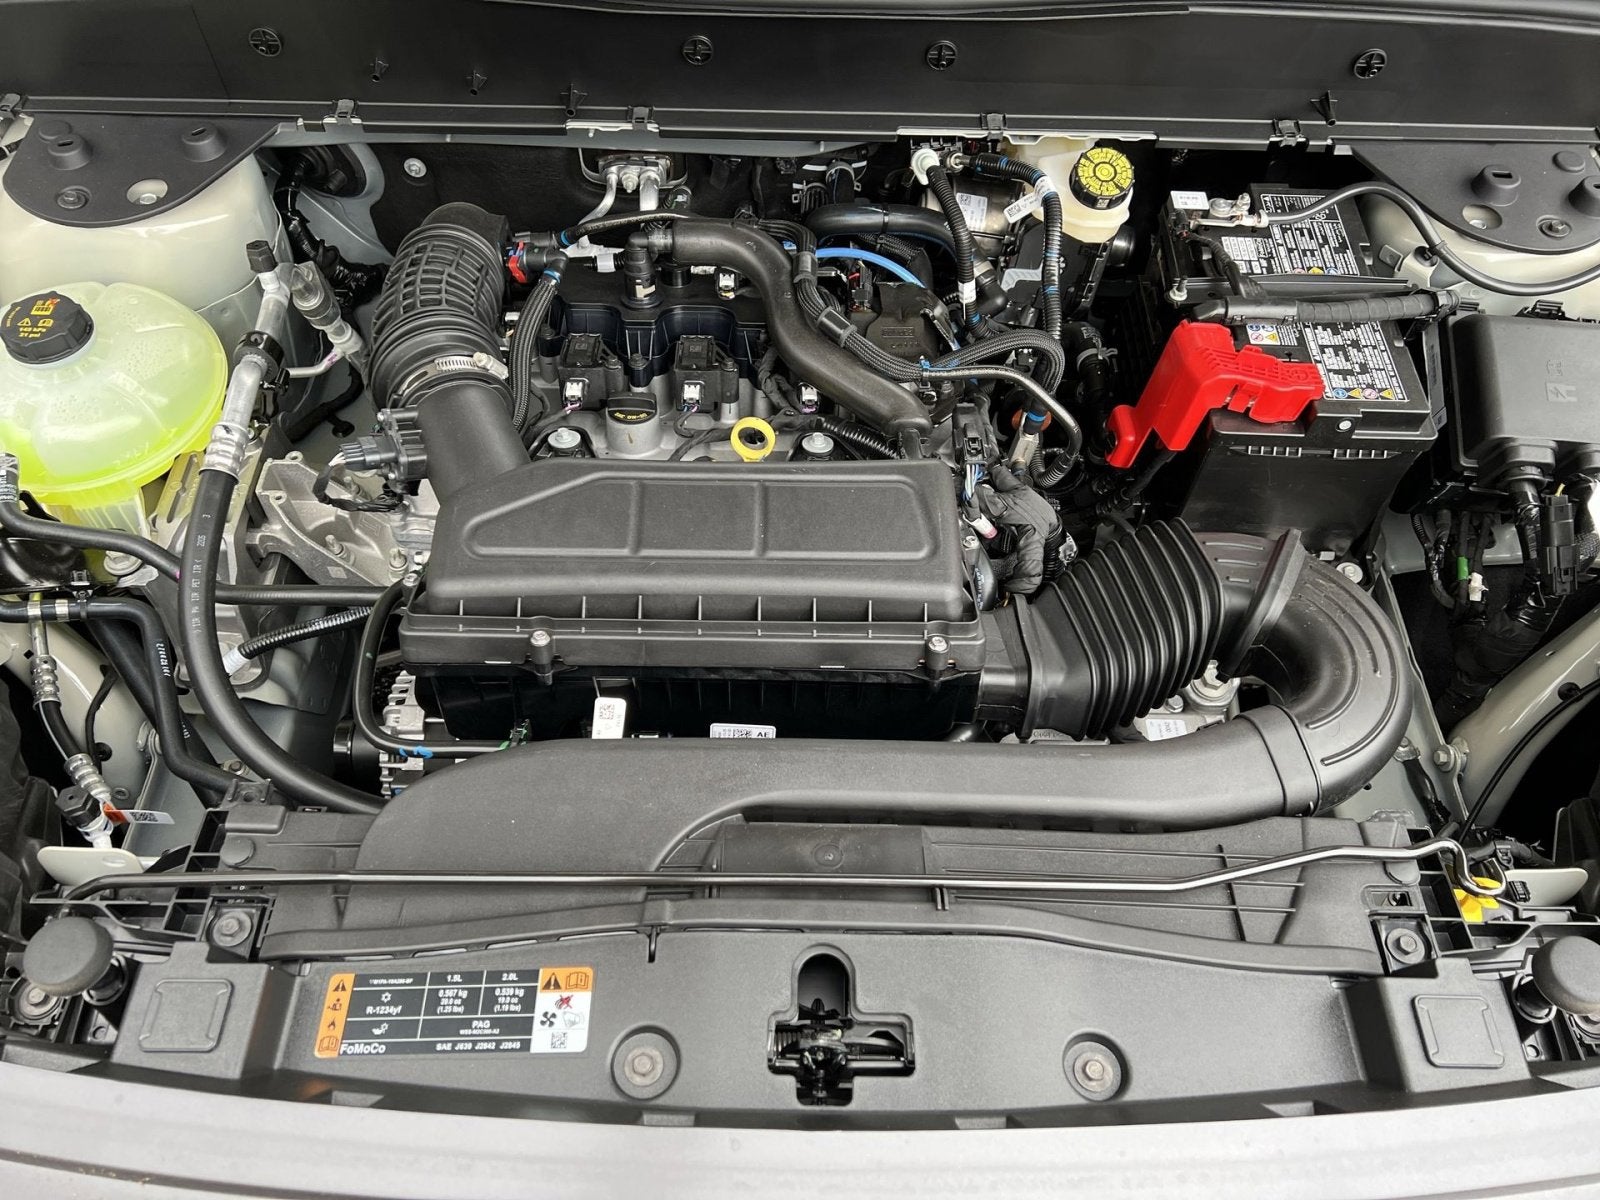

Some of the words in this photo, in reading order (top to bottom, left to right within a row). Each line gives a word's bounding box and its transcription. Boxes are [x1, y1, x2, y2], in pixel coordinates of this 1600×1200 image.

[502, 973, 518, 981] 2.0L
[458, 990, 468, 998] kg
[515, 988, 525, 997] kg
[366, 1006, 402, 1016] R-1234yf
[472, 1020, 490, 1028] PAG
[340, 1043, 386, 1054] FoMoCo
